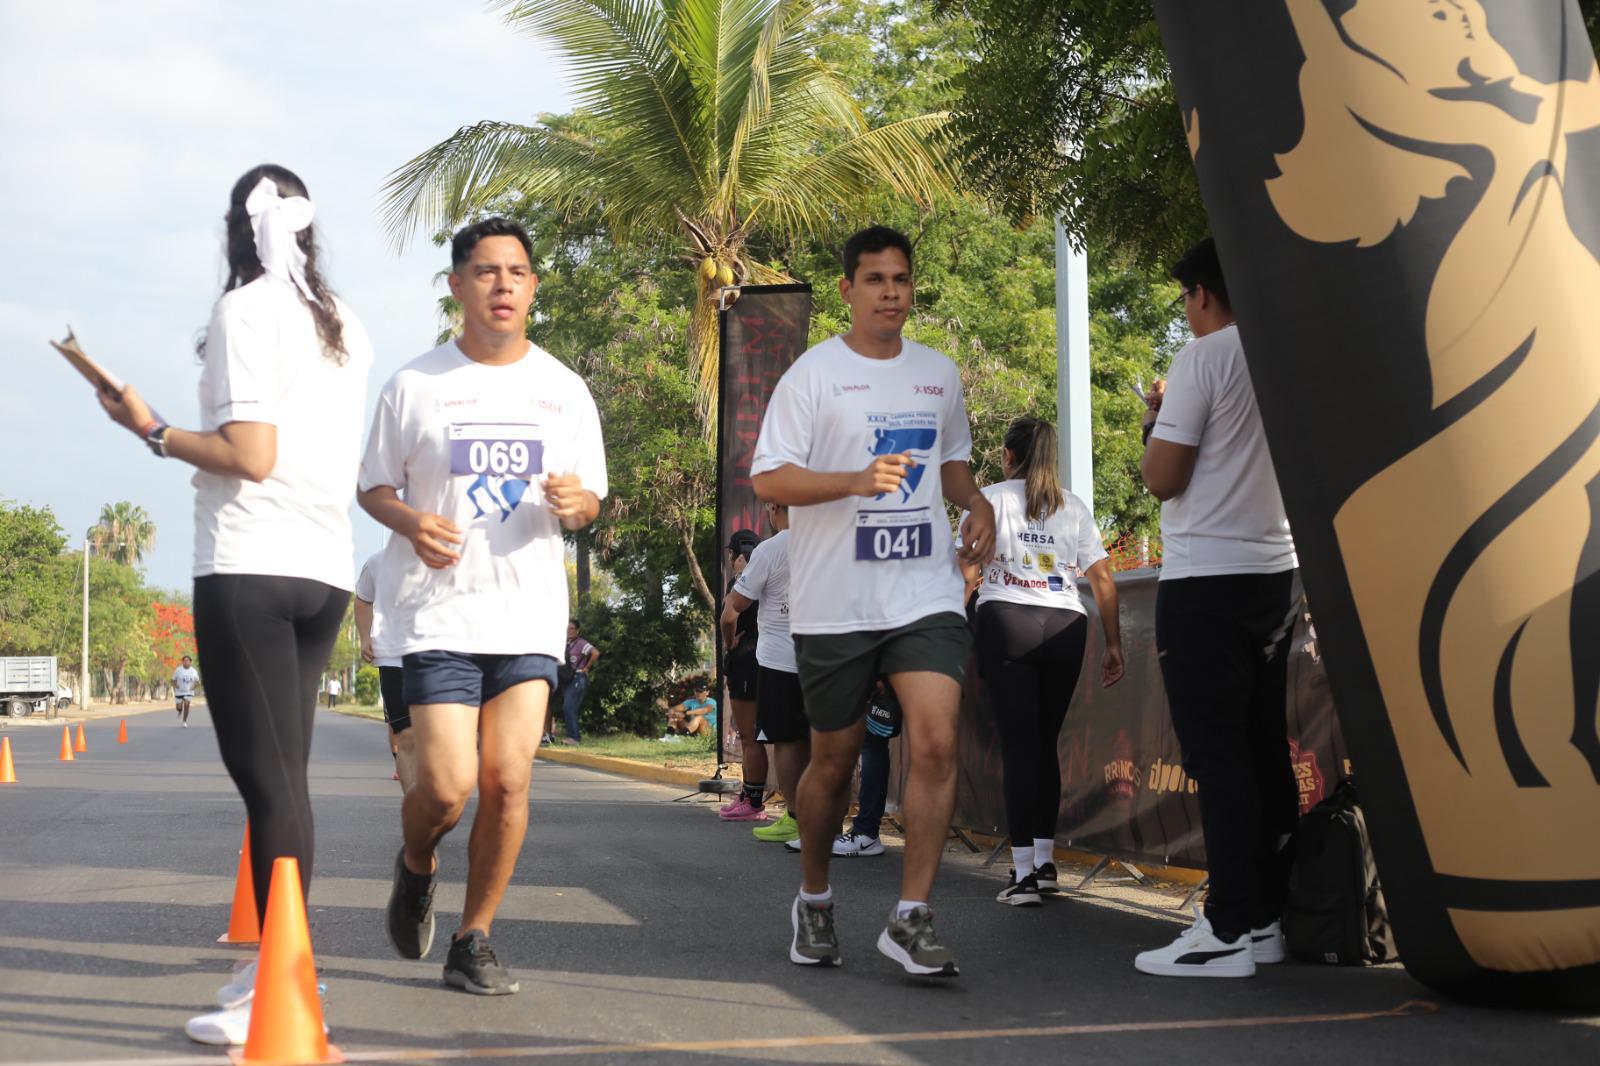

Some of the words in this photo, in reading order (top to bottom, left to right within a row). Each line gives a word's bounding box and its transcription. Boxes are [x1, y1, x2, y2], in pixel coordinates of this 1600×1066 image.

[469, 440, 529, 474] 069
[873, 526, 920, 559] 041
[1017, 532, 1055, 545] HERSA
[1004, 570, 1047, 589] VENADOS
